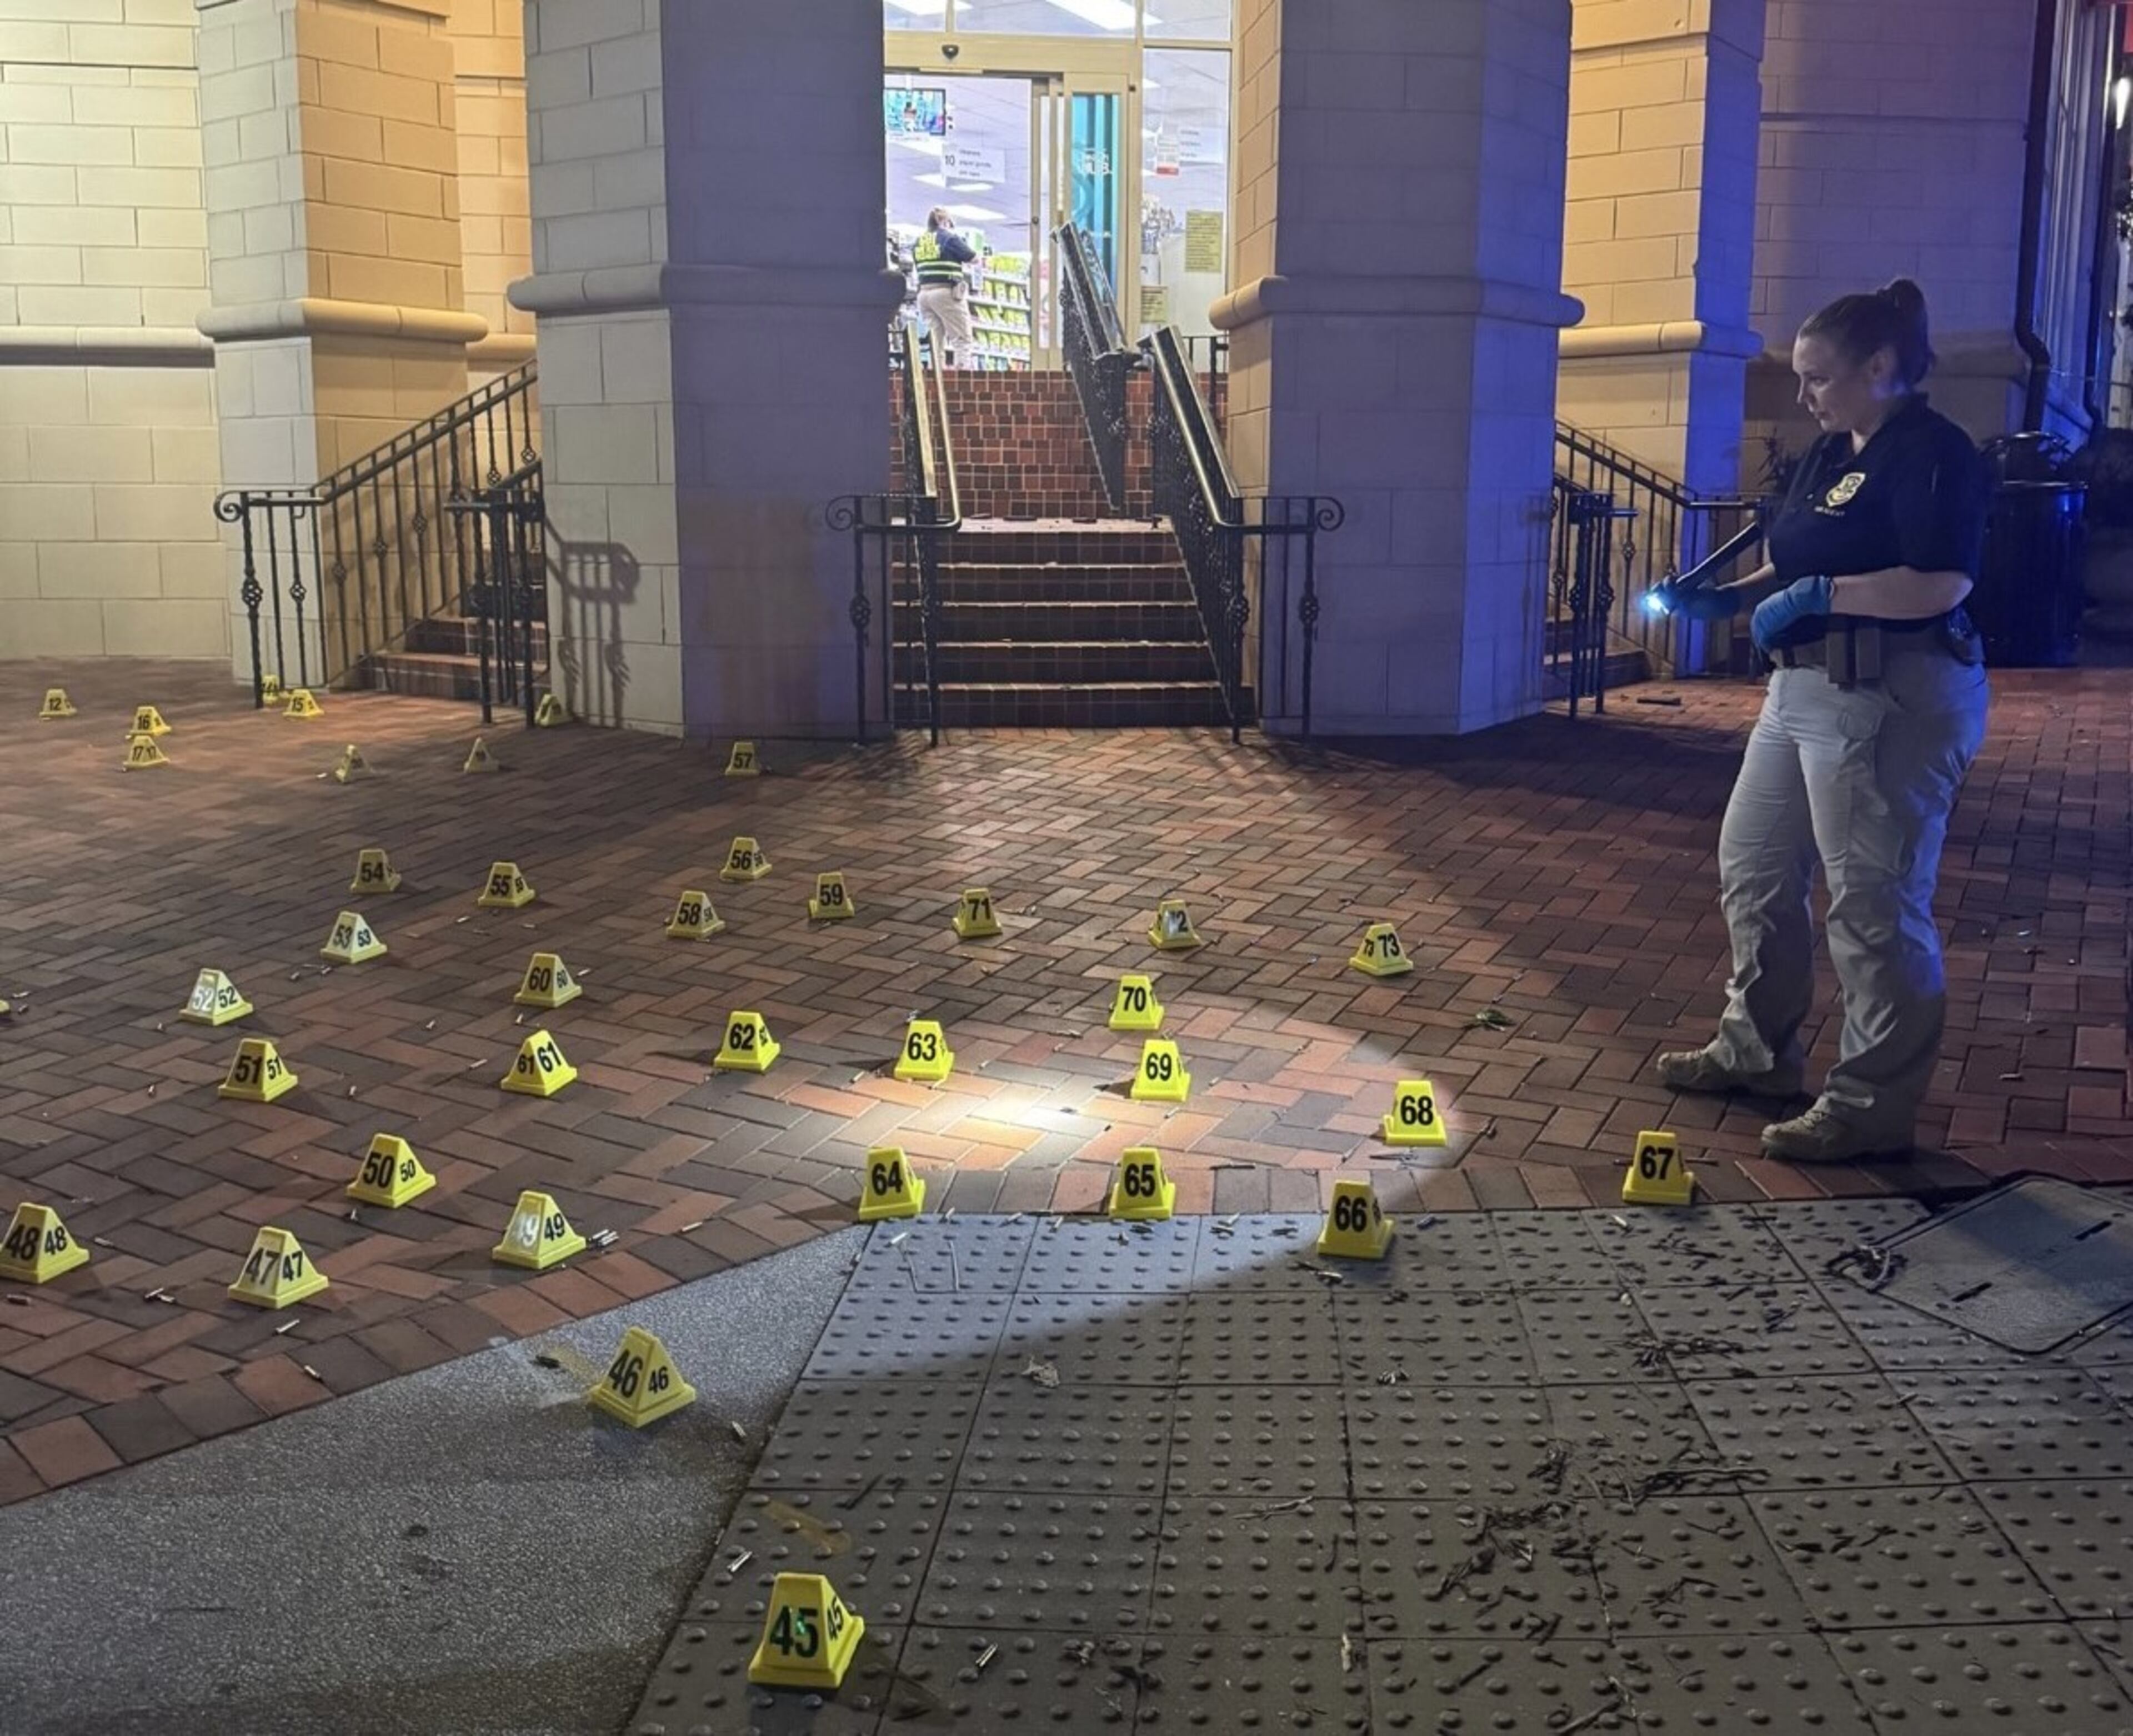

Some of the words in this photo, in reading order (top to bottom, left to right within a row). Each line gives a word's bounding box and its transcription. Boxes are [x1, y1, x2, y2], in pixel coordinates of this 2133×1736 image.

[49, 697, 62, 711] 12
[292, 697, 304, 713] 15
[138, 714, 150, 731] 16
[132, 746, 144, 762] 17
[734, 752, 753, 769] 57
[360, 862, 383, 883] 54
[730, 849, 752, 870] 56
[489, 874, 512, 896] 55
[820, 883, 844, 906] 59
[677, 902, 700, 926] 58
[967, 898, 991, 921] 71
[333, 924, 353, 949] 53
[358, 928, 372, 948] 53
[1377, 932, 1400, 958] 73
[529, 966, 550, 993] 60
[192, 985, 214, 1010] 52
[218, 985, 238, 1008] 52
[1122, 985, 1146, 1012] 70
[729, 1022, 755, 1050] 62
[907, 1032, 937, 1062] 63
[235, 1055, 262, 1084] 51
[267, 1056, 282, 1080] 51
[517, 1054, 534, 1075] 61
[537, 1040, 562, 1073] 61
[1146, 1052, 1172, 1082] 69
[1400, 1095, 1434, 1125] 68
[363, 1151, 395, 1189] 50
[400, 1159, 416, 1182] 50
[1640, 1145, 1675, 1180] 67
[872, 1160, 904, 1196] 64
[1124, 1163, 1156, 1198] 65
[1335, 1194, 1367, 1233] 66
[44, 1225, 67, 1255] 48
[544, 1213, 565, 1242] 49
[4, 1223, 41, 1261] 48
[245, 1247, 281, 1285] 47
[282, 1249, 304, 1282] 47
[608, 1348, 643, 1398] 46
[649, 1366, 670, 1395] 46
[769, 1605, 819, 1658] 45
[826, 1596, 844, 1640] 45
